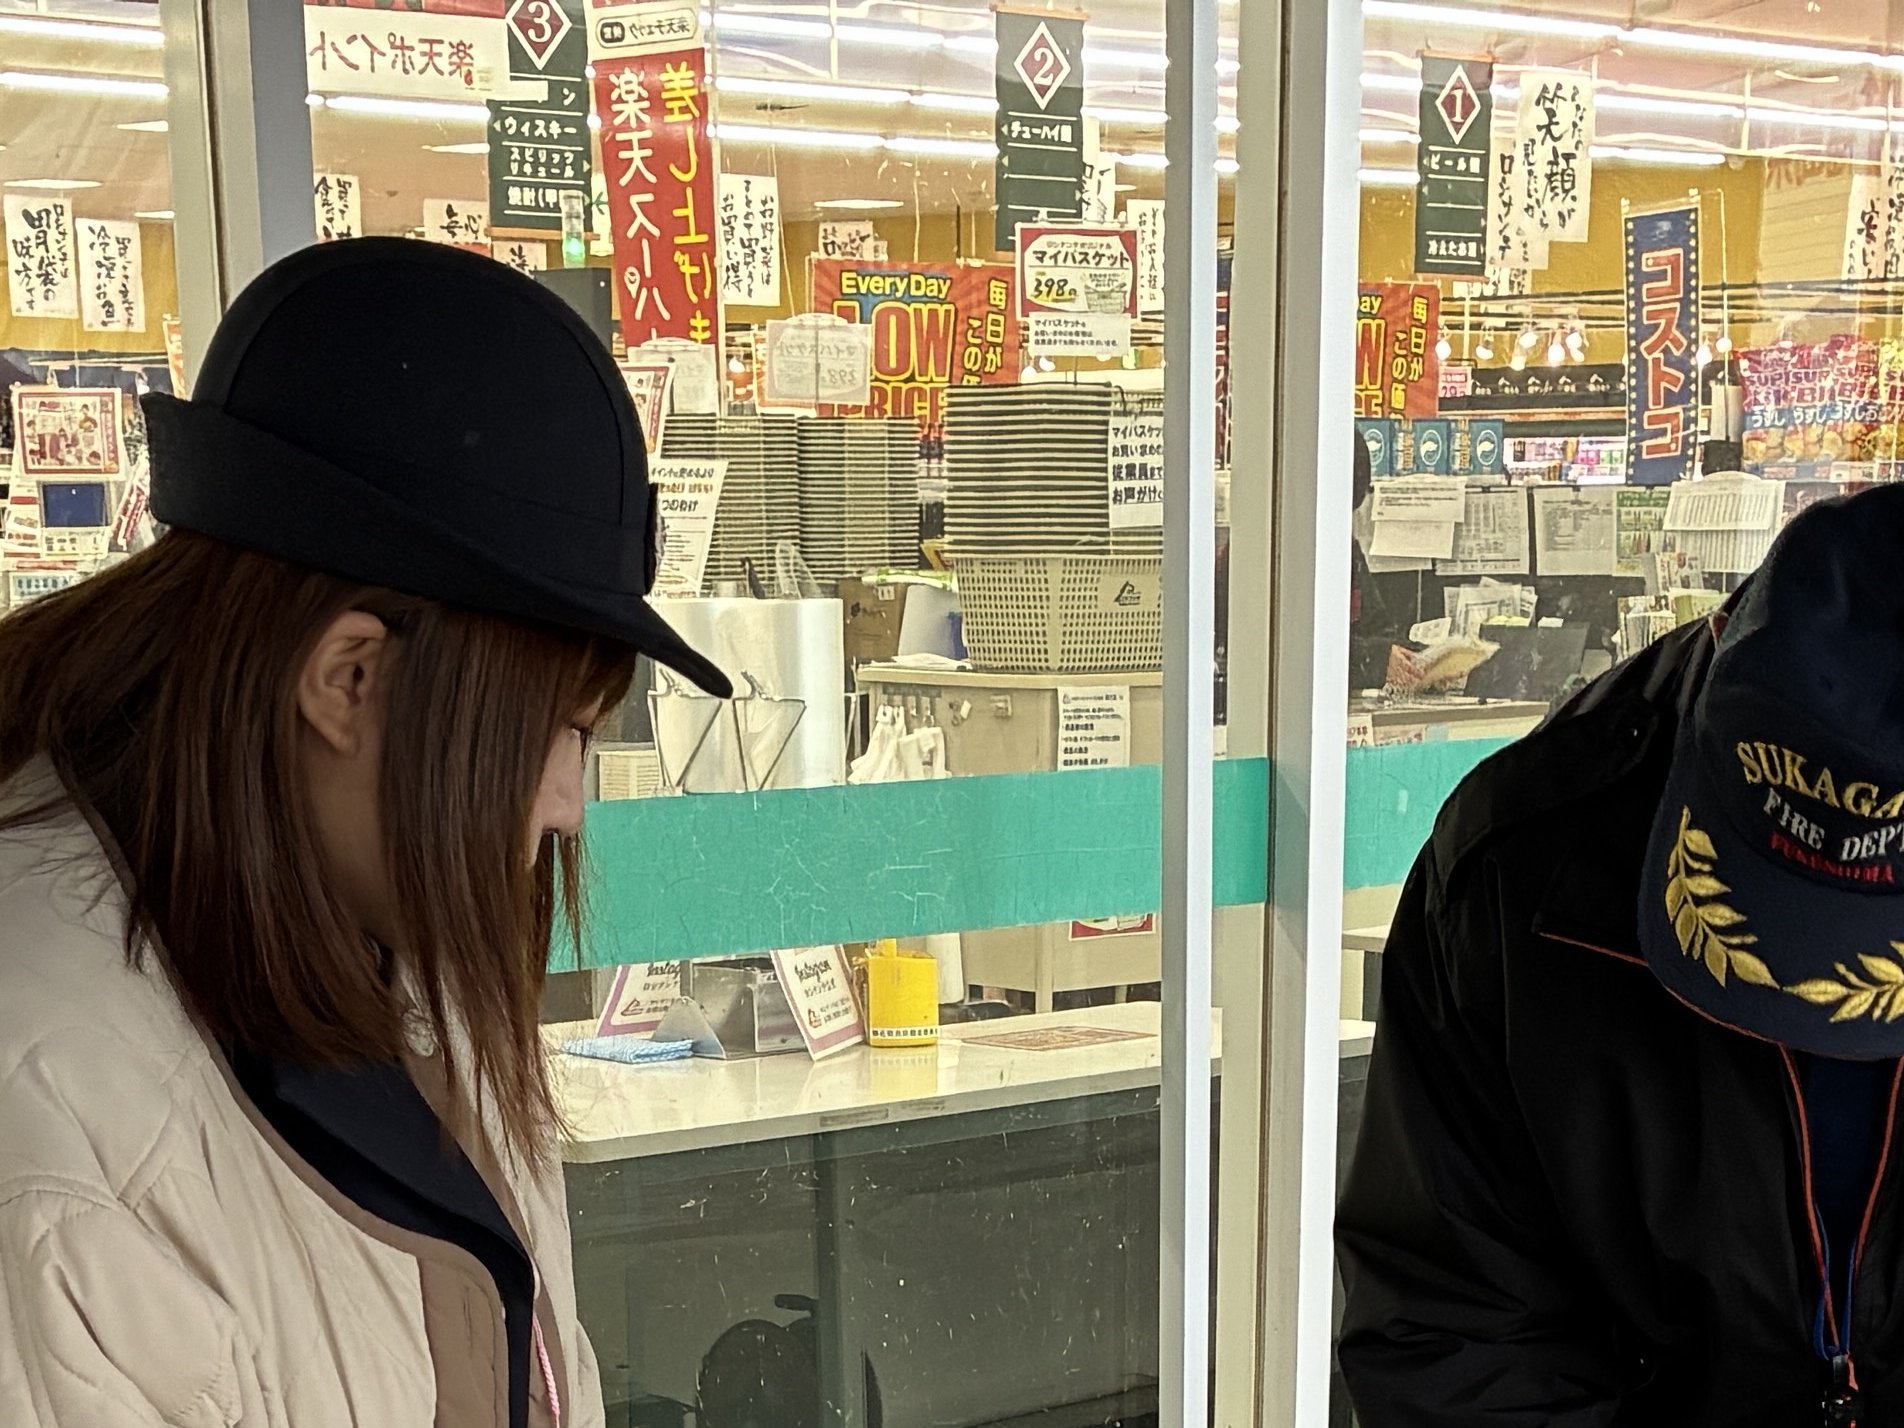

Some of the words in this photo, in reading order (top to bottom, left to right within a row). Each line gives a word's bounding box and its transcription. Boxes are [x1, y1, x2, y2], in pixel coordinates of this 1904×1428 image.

[526, 1, 553, 43] 3
[1032, 47, 1055, 86] 2
[1451, 88, 1465, 123] 1
[504, 116, 577, 140] ウィスキー
[507, 186, 561, 208] 焼酎(甲
[1032, 250, 1130, 267] マイバスケット
[985, 279, 1007, 373] 毎日が
[1408, 295, 1428, 382] 毎日が
[1639, 248, 1686, 460] コストコ
[1389, 330, 1409, 420] この価
[1752, 408, 1786, 428] うすし
[1793, 406, 1827, 425] うすし
[1763, 786, 1827, 852] FIRE
